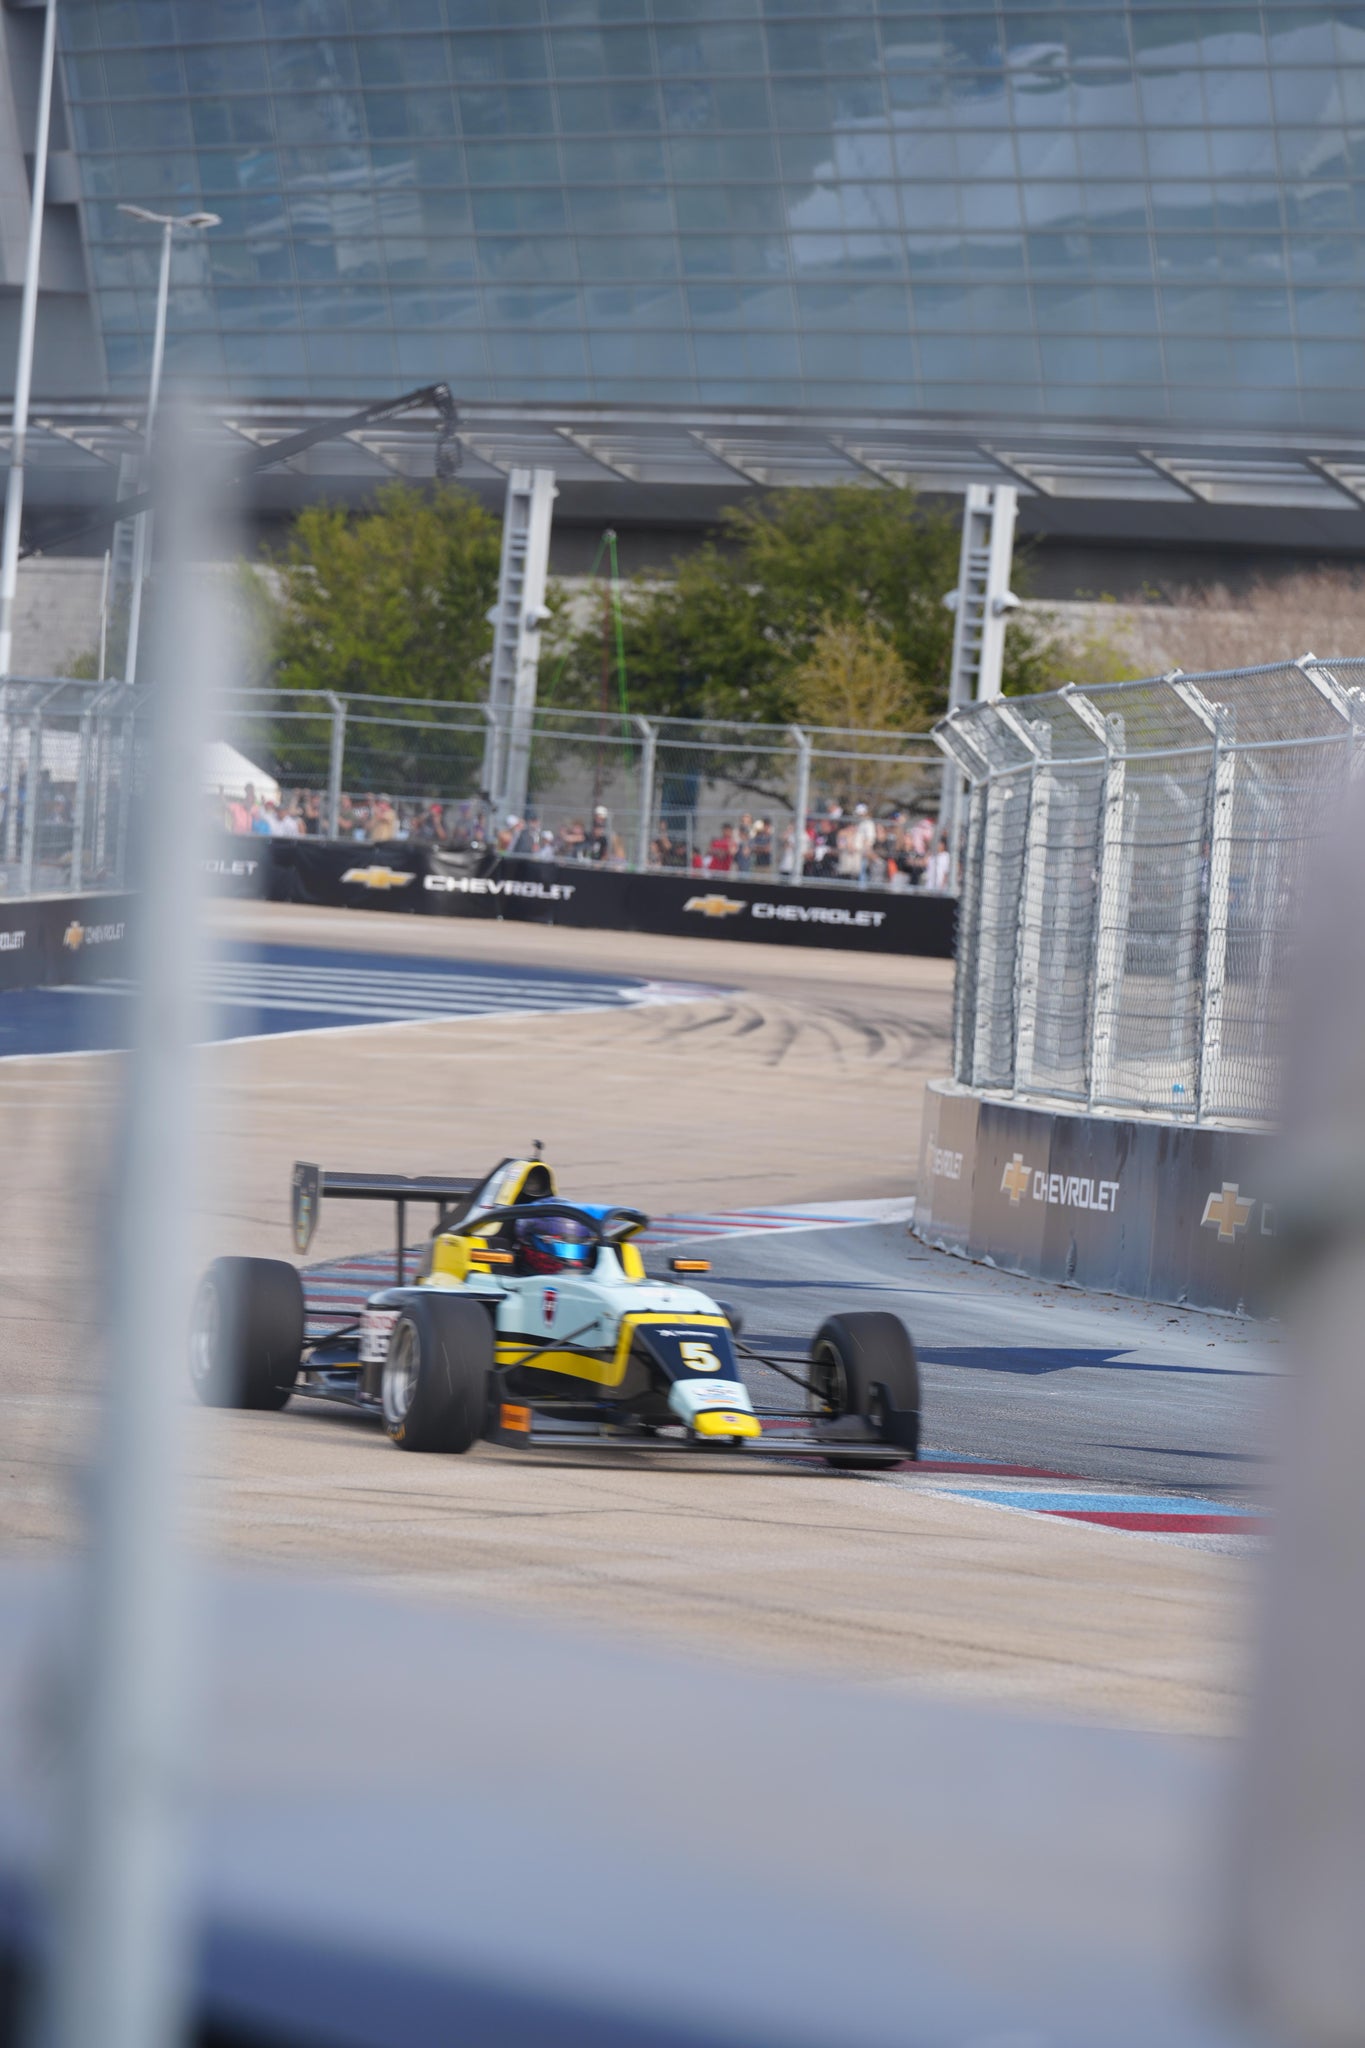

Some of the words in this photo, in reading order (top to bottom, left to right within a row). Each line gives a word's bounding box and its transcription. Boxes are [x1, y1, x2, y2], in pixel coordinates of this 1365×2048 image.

[423, 874, 576, 901] CHEVROLET
[751, 902, 886, 927] CHEVROLET
[1033, 1170, 1120, 1213] CHEVROLET
[680, 1342, 721, 1373] 5
